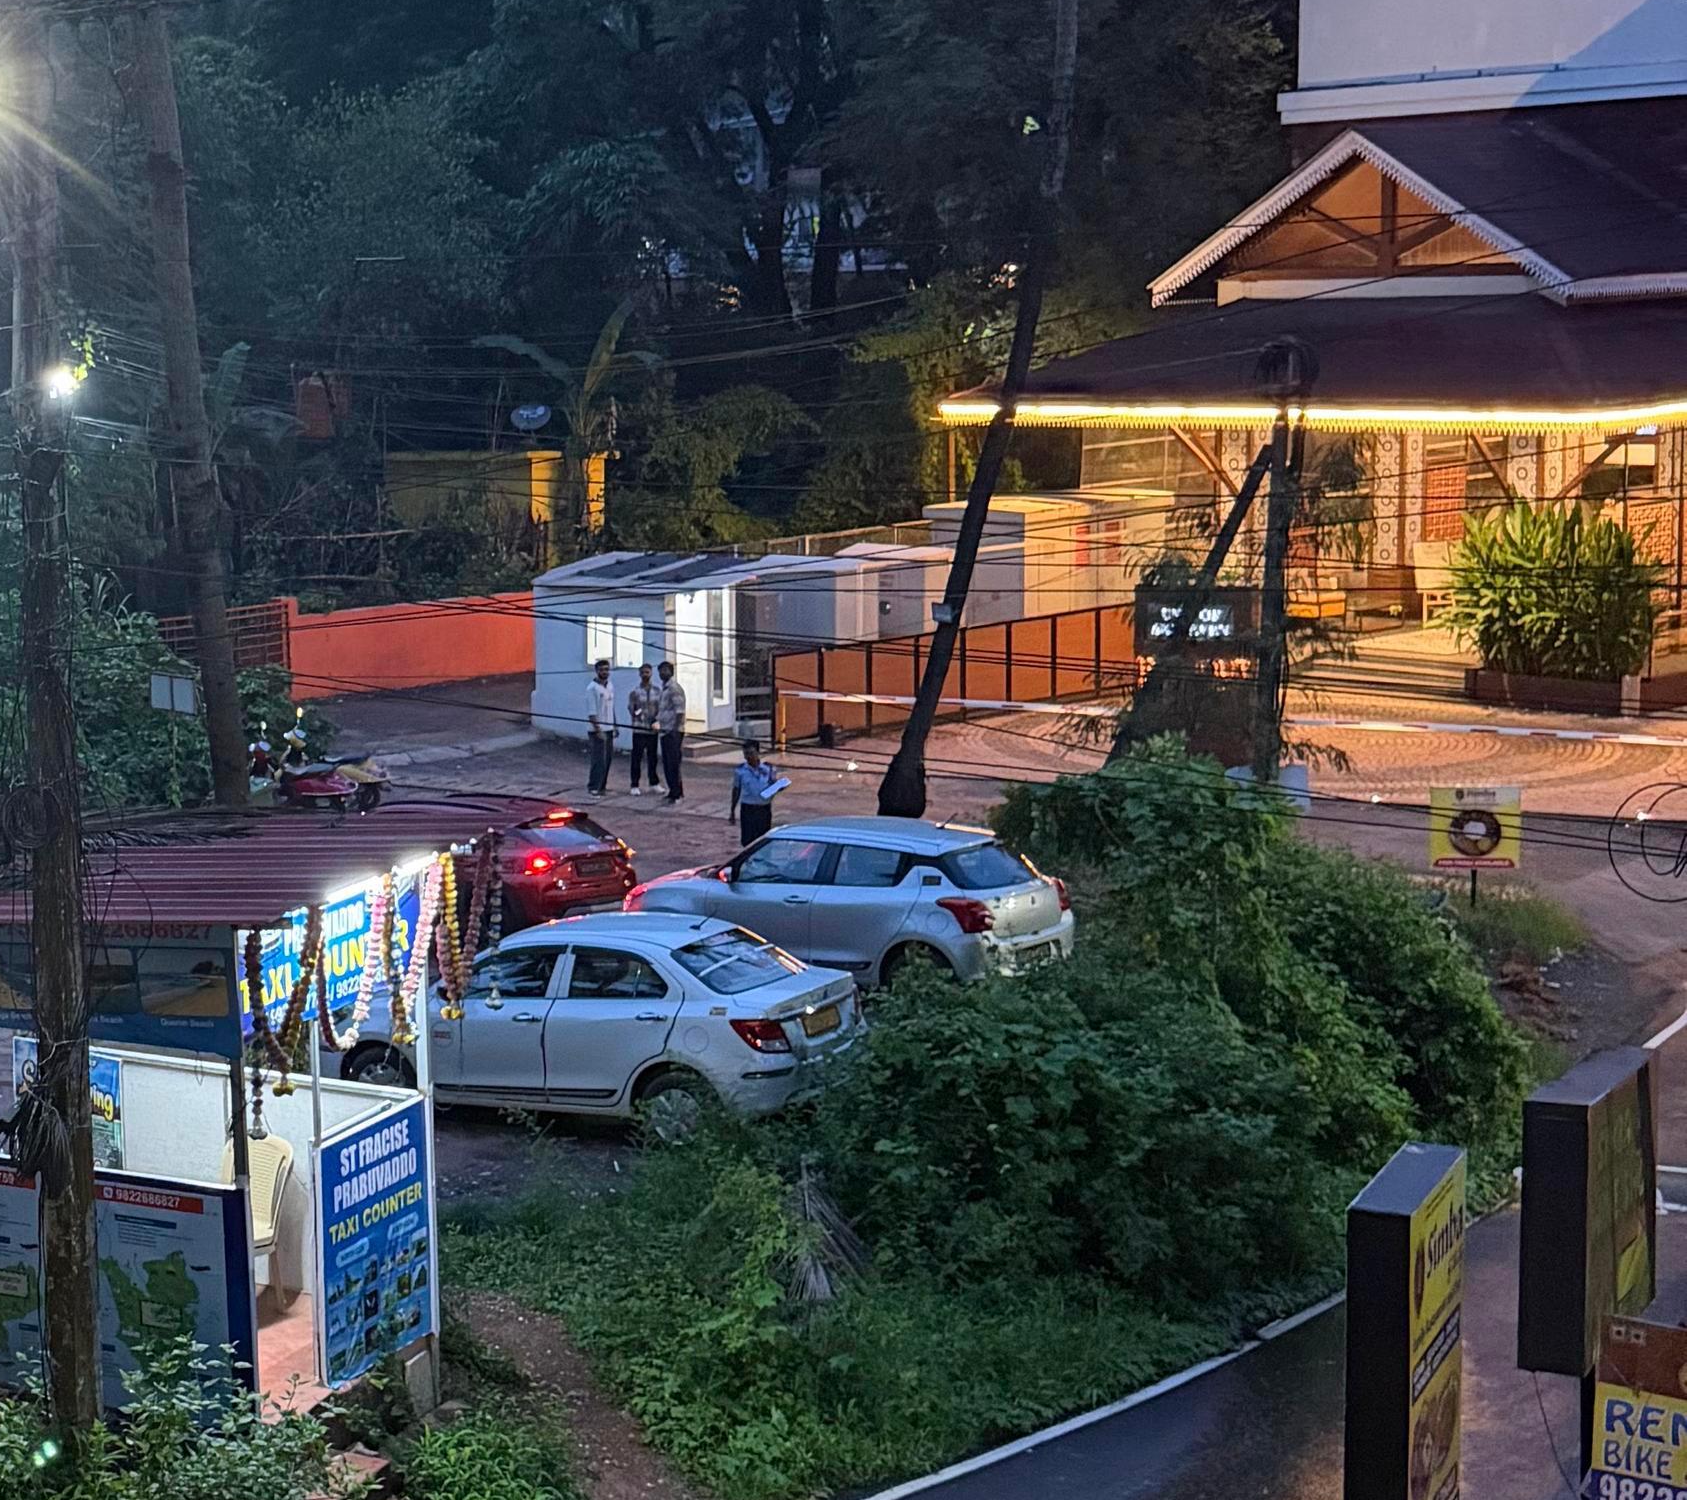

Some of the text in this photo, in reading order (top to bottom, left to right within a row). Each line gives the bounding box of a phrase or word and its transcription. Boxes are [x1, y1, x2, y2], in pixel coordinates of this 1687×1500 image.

[340, 1118, 410, 1177] ST FRACISE
[333, 1147, 417, 1214] PRABUVADDO
[328, 1214, 359, 1245] TAXI
[363, 1181, 422, 1228] COUNTER
[1603, 1439, 1673, 1481] BIKE
